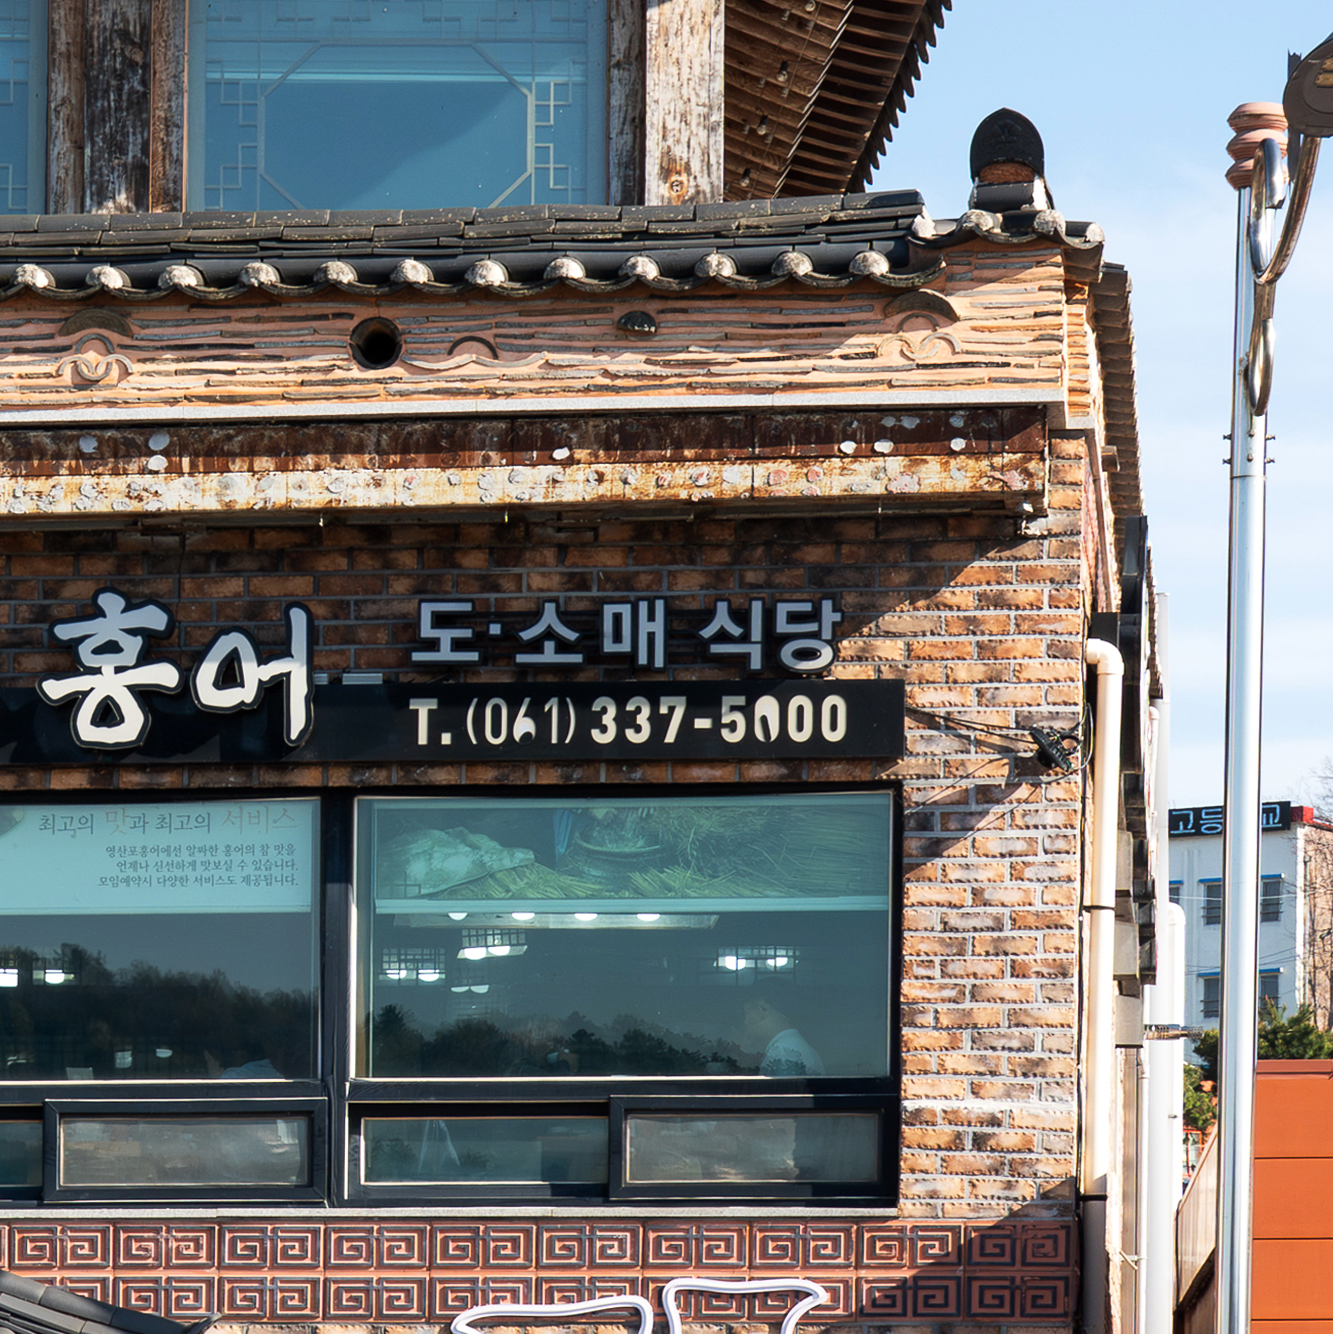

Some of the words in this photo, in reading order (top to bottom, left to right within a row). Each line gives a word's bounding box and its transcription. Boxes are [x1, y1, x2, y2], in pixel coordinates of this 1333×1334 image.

[698, 599, 842, 671] 식당
[41, 590, 310, 746] 홍어
[408, 697, 452, 746] T.
[466, 696, 576, 746] (061)
[590, 693, 848, 745] 337-5000
[38, 812, 95, 835] 최고의
[105, 806, 149, 835] 맛과
[154, 812, 212, 835] 최고의
[220, 805, 299, 834] 서비스
[1169, 803, 1283, 835] 고등교
[105, 843, 183, 858] 영산포홍어에선
[222, 843, 256, 857] 홍어의
[259, 843, 271, 857] 참
[273, 843, 297, 857] 맛을
[115, 859, 150, 873] 언제나
[152, 859, 197, 873] 신선하게
[200, 858, 234, 872] 맛보실
[237, 859, 248, 872] 수
[251, 858, 300, 872] 있습니다.
[97, 874, 153, 888] 모임예약시
[156, 874, 190, 888] 다양한
[192, 874, 238, 887] 서비스도
[240, 873, 300, 887] 제공됩니다.
